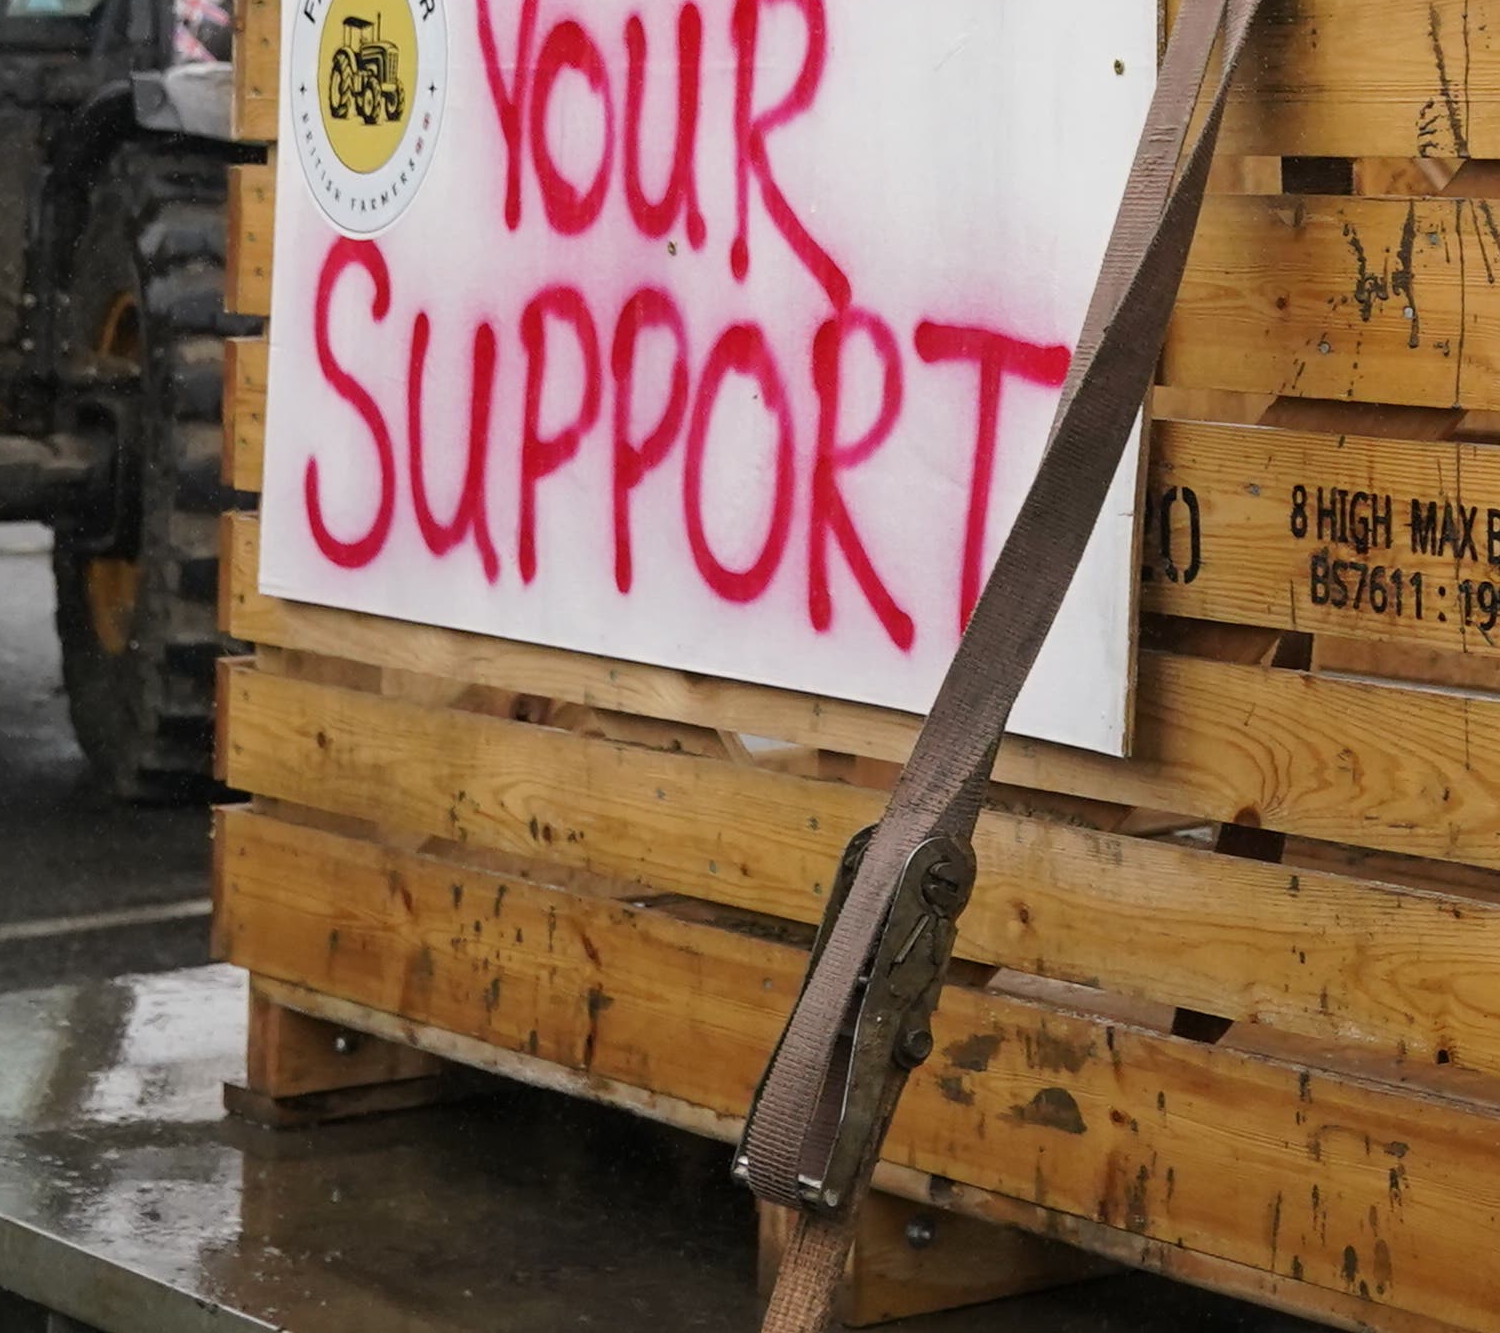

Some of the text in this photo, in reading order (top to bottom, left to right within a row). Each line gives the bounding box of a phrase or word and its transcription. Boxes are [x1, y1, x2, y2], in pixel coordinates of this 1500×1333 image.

[302, 112, 416, 212] BRITISH FARMERS
[304, 235, 1072, 653] SUPPORT
[1290, 485, 1308, 538] 8
[1316, 486, 1392, 554] HIGH
[1410, 497, 1478, 562] MAX
[1310, 551, 1423, 620] BS7611
